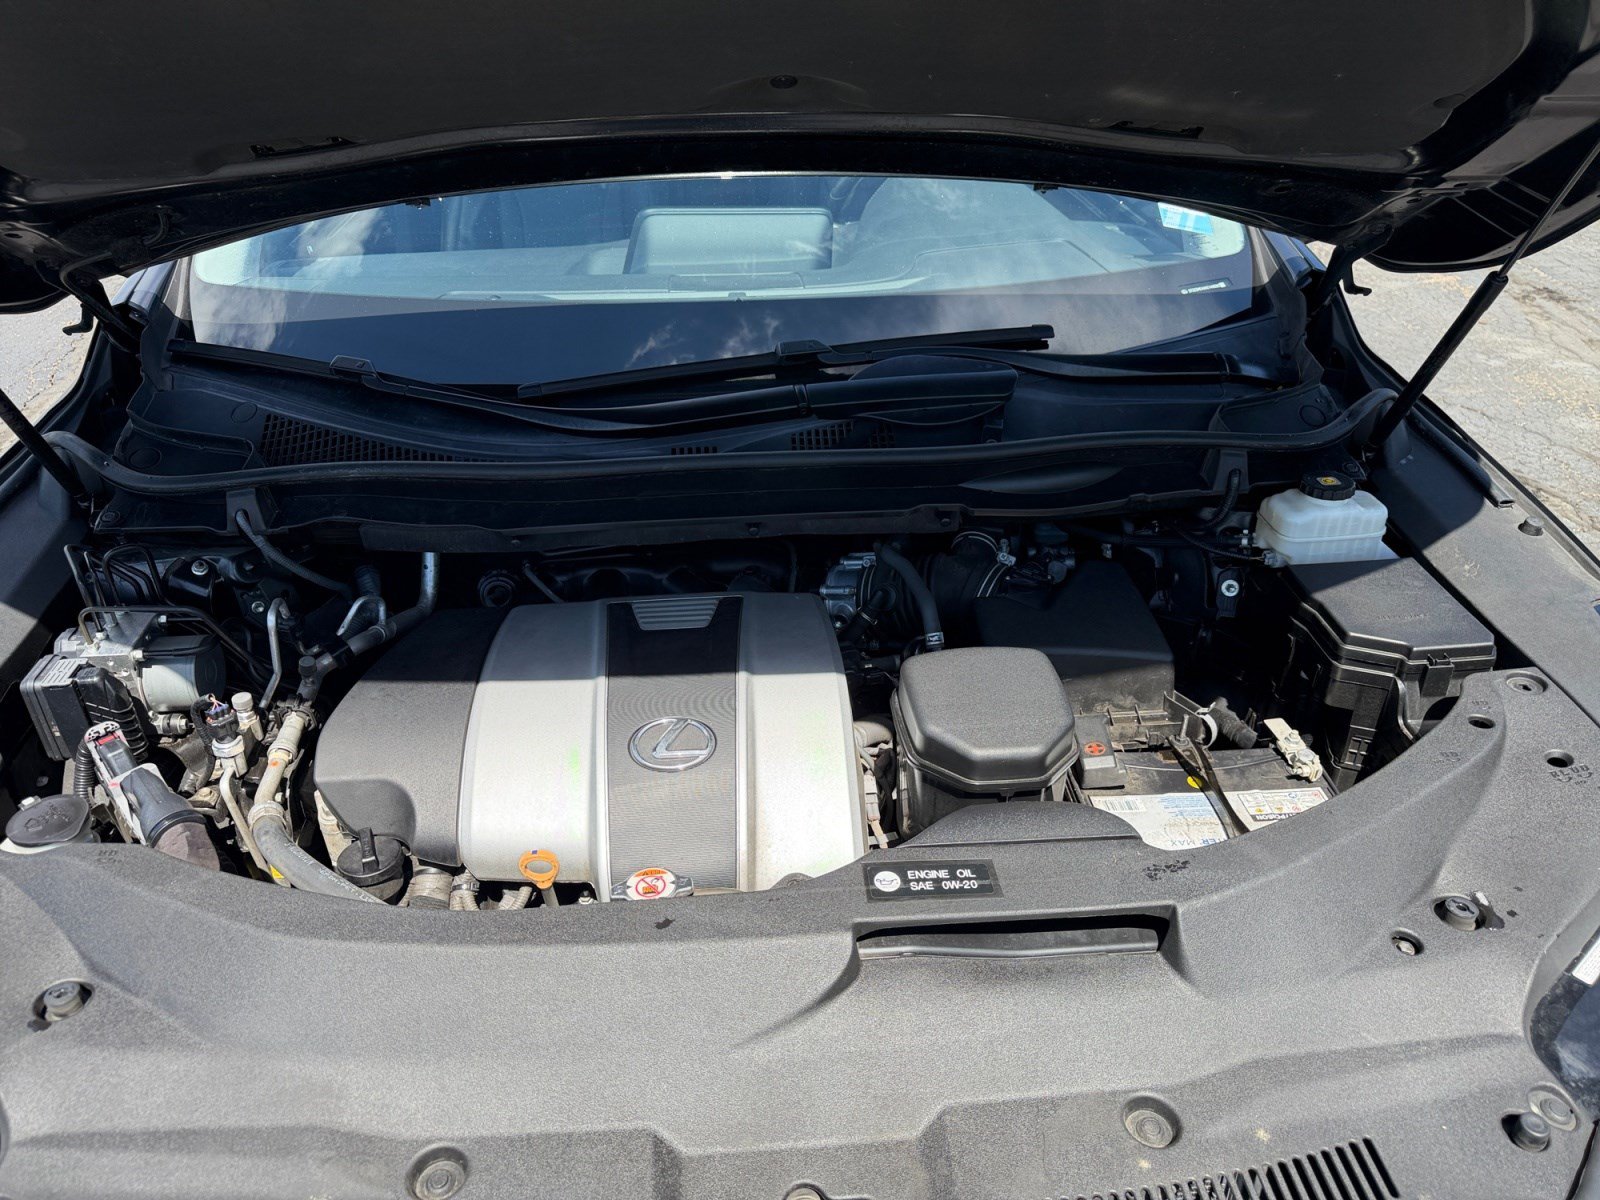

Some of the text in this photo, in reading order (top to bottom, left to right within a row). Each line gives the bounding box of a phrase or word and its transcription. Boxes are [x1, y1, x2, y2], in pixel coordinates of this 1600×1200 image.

[907, 869, 976, 879] ENGINE OIL
[910, 880, 978, 891] SAE 0W-20
